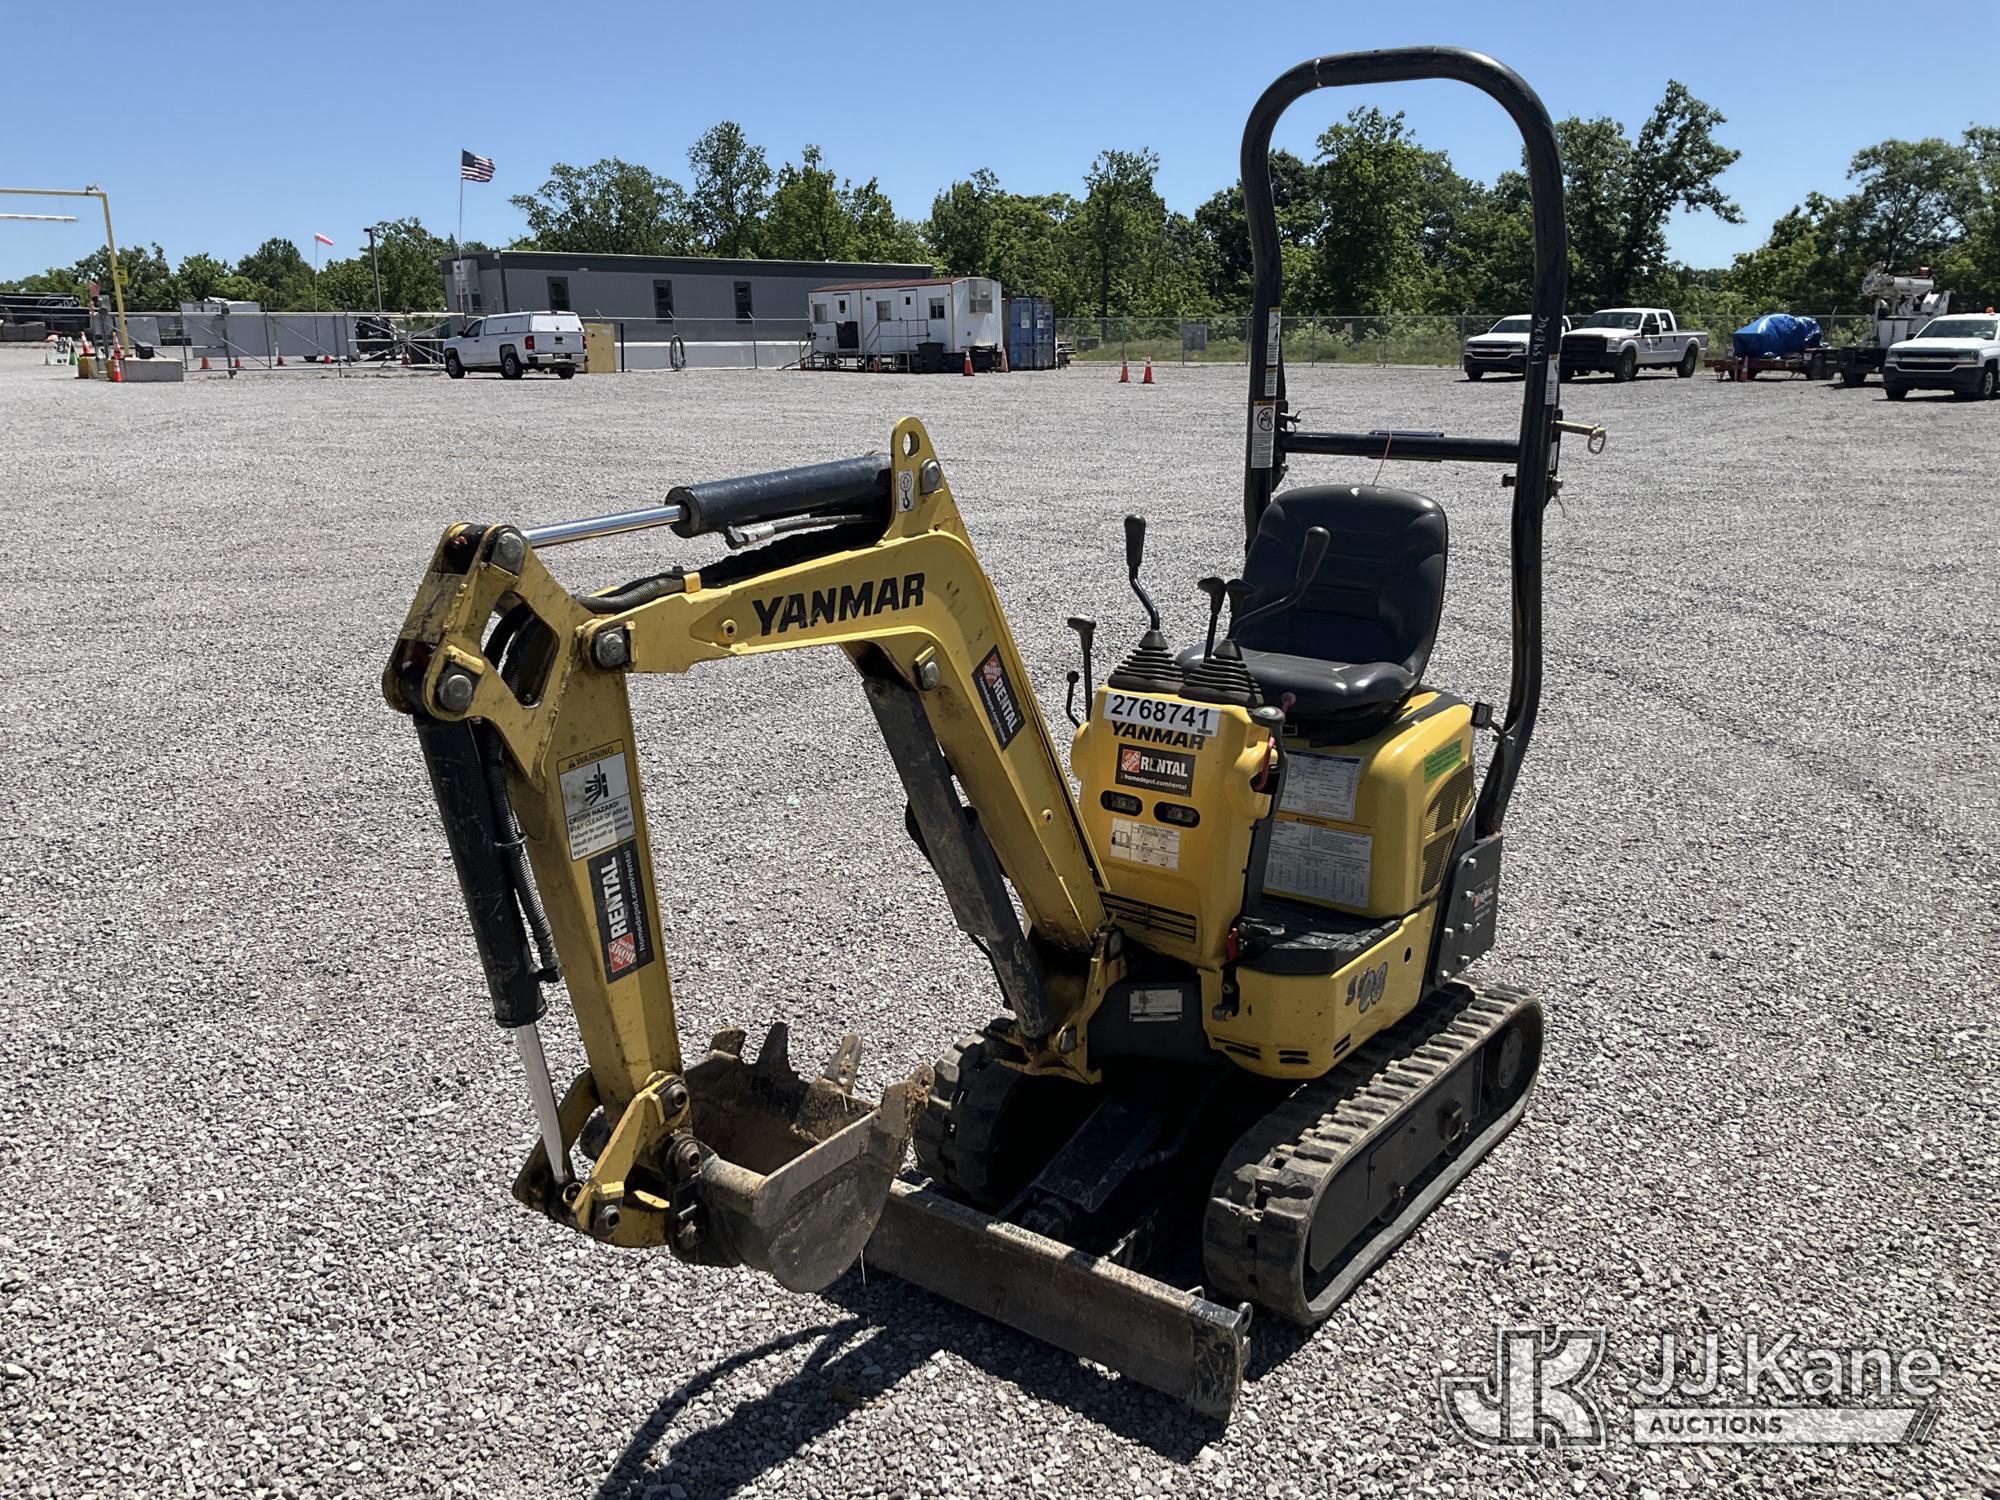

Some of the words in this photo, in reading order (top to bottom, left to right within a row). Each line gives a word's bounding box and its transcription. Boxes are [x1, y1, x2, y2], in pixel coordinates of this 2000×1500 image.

[752, 572, 925, 636] YANMAR
[992, 676, 1018, 734] RENTAL
[1111, 695, 1210, 729] 2768741
[1111, 720, 1206, 750] YANMAR
[576, 745, 614, 765] WARNING
[1124, 774, 1187, 790] homedepot.com/rental
[585, 815, 605, 827] CLEAR
[600, 856, 628, 939] RENTAL
[624, 850, 646, 951] homedepot.com/rental
